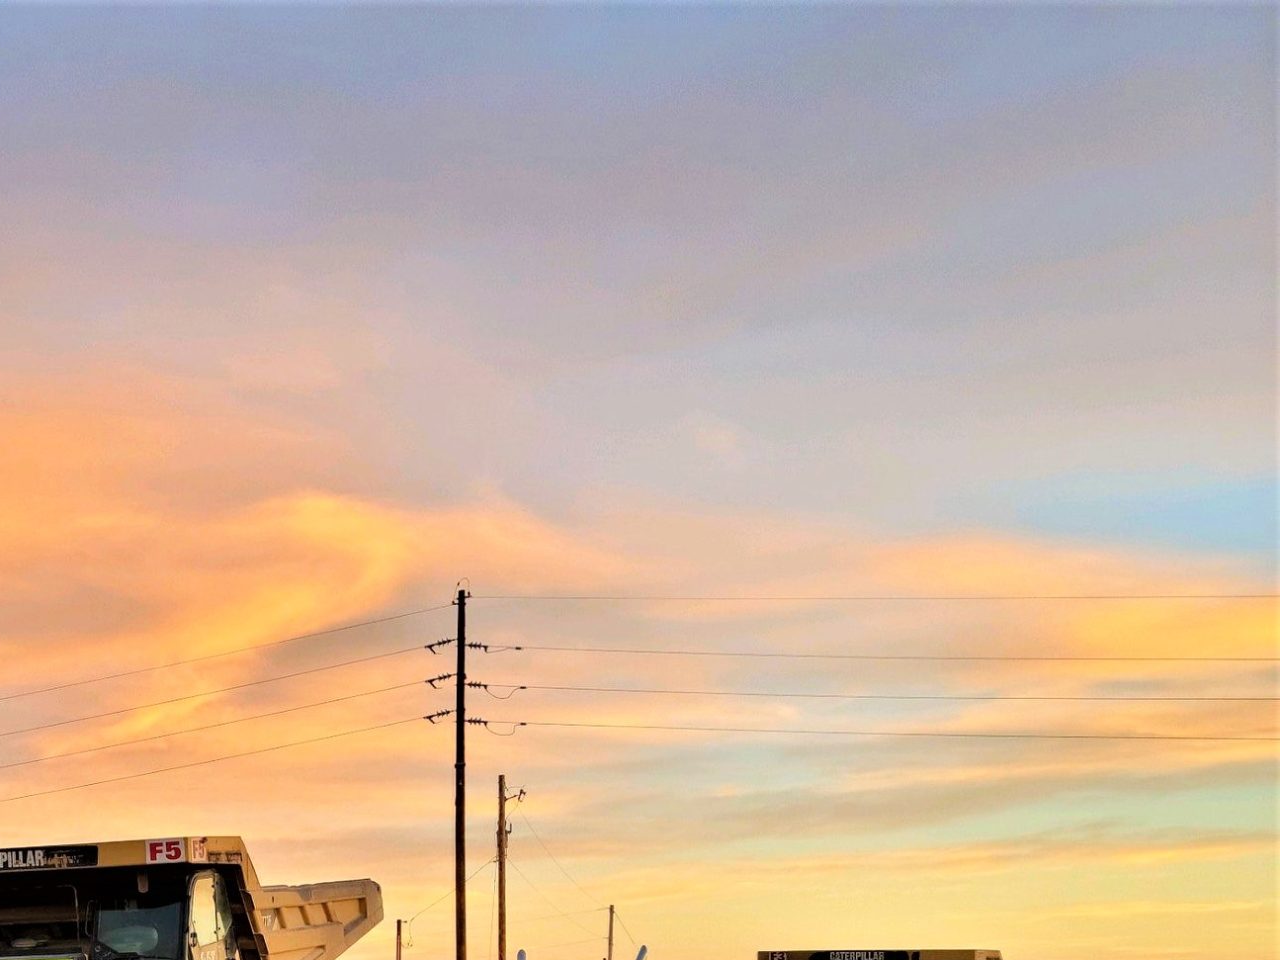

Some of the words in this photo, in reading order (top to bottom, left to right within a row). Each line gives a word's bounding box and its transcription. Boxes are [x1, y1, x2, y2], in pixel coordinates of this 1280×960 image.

[149, 841, 182, 861] F5
[769, 951, 786, 960] F3
[829, 951, 885, 960] CATERPILLAR
